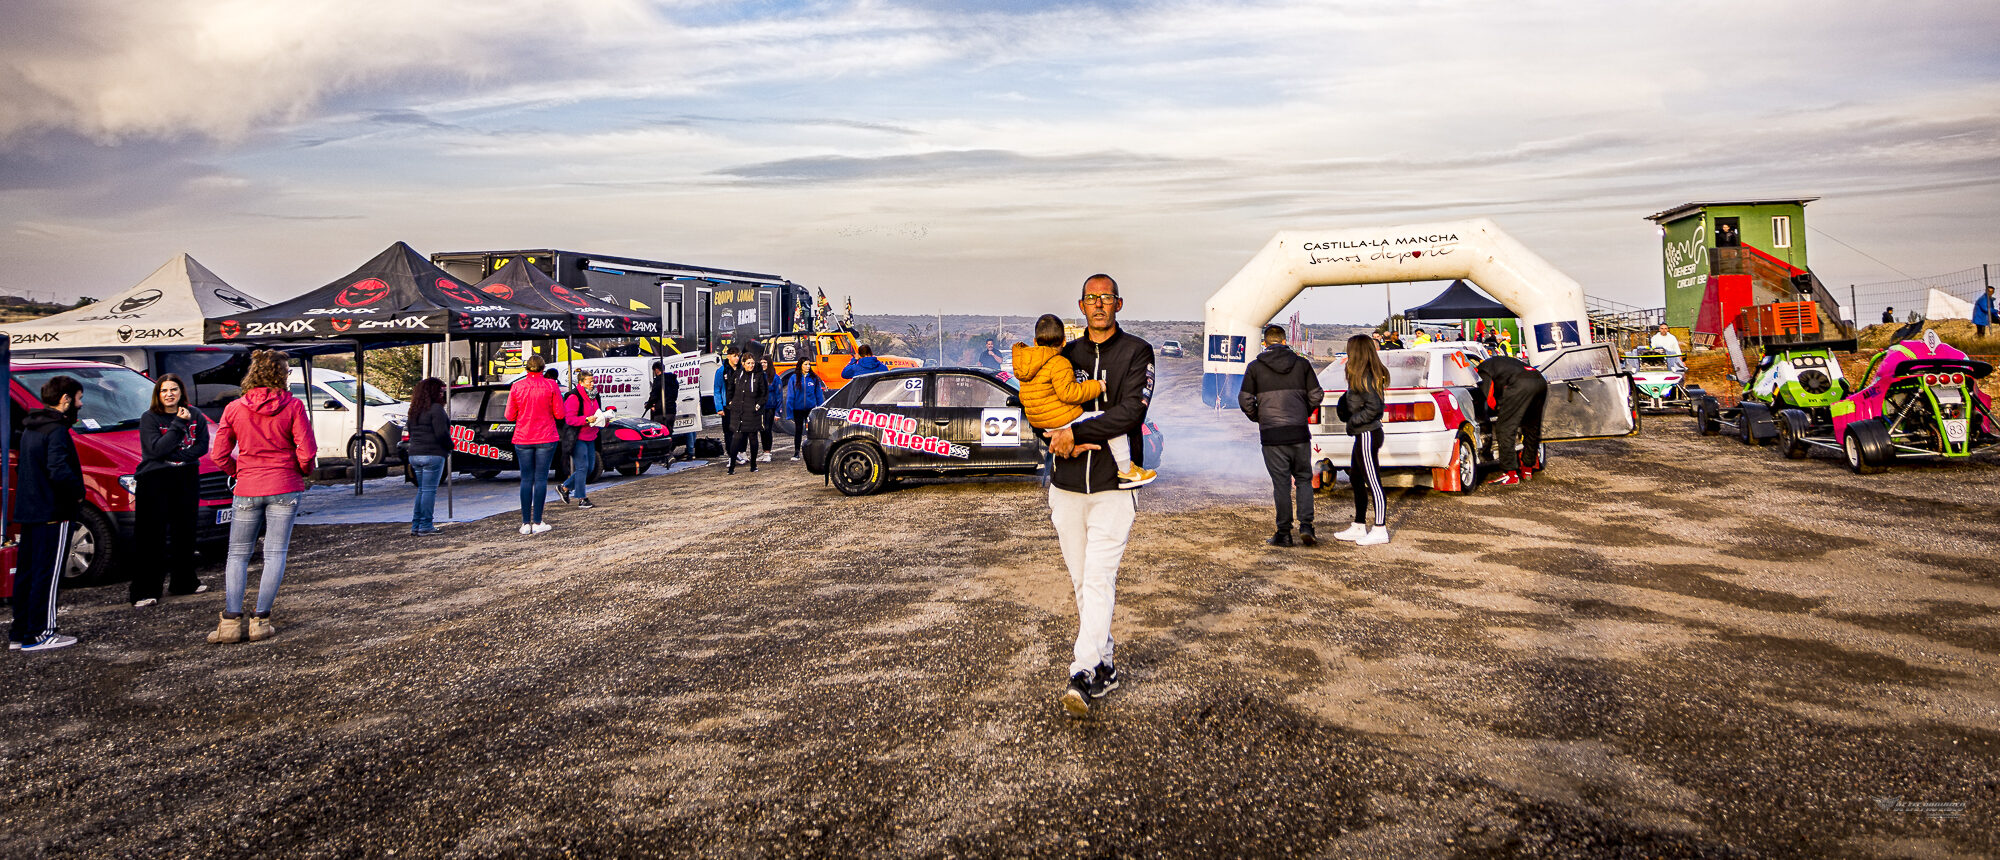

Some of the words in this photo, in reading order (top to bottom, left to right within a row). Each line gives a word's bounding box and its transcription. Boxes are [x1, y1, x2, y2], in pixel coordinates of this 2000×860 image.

[1303, 238, 1390, 251] CASTILLA-LA
[1395, 233, 1459, 245] MANCHA
[714, 290, 733, 305] EQUIPO
[246, 318, 316, 336] 24MX
[473, 316, 512, 329] 24MX
[530, 317, 565, 332] 24MX
[587, 317, 615, 329] 24MX
[632, 320, 658, 333] 24MX
[11, 331, 60, 345] 24MX
[134, 327, 184, 339] 24MX
[1450, 350, 1471, 369] 12
[905, 379, 923, 390] 62
[848, 408, 917, 434] Chollo
[984, 416, 1019, 438] 62
[1949, 424, 1963, 435] 83
[881, 428, 951, 456] Rueda
